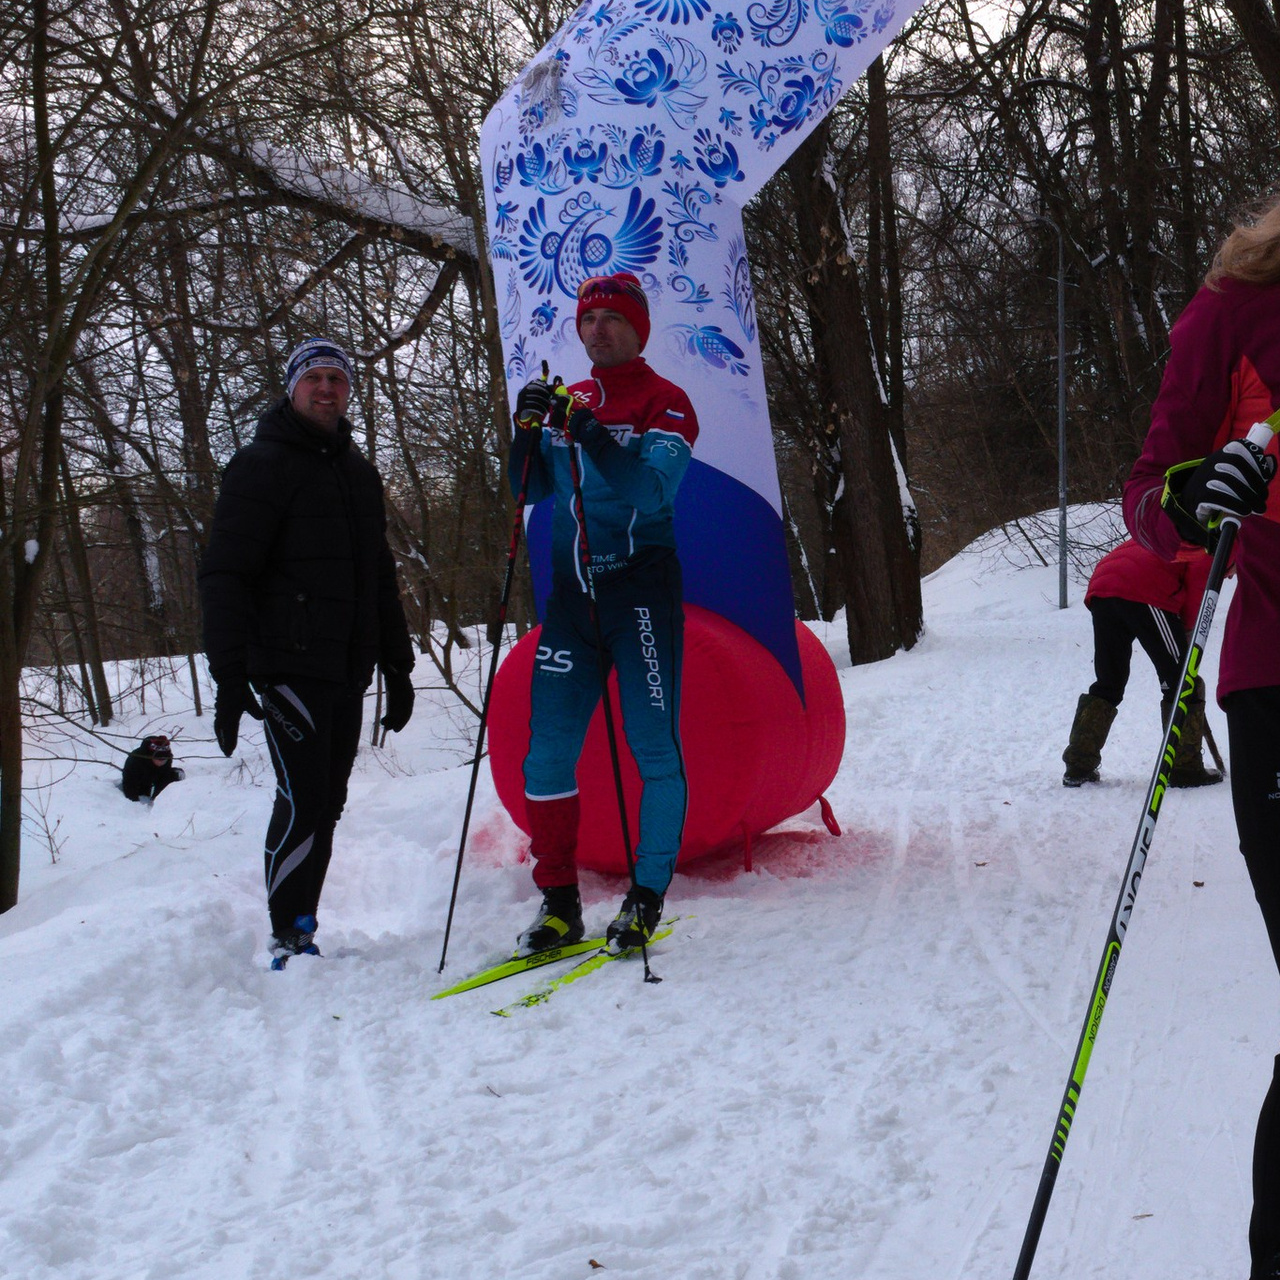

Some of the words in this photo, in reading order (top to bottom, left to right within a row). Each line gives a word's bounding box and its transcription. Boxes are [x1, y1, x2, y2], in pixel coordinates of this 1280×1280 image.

[591, 553, 617, 563] TIME
[1199, 597, 1214, 638] CARBON
[634, 607, 665, 711] PROSPORT
[526, 949, 563, 967] FISCHER
